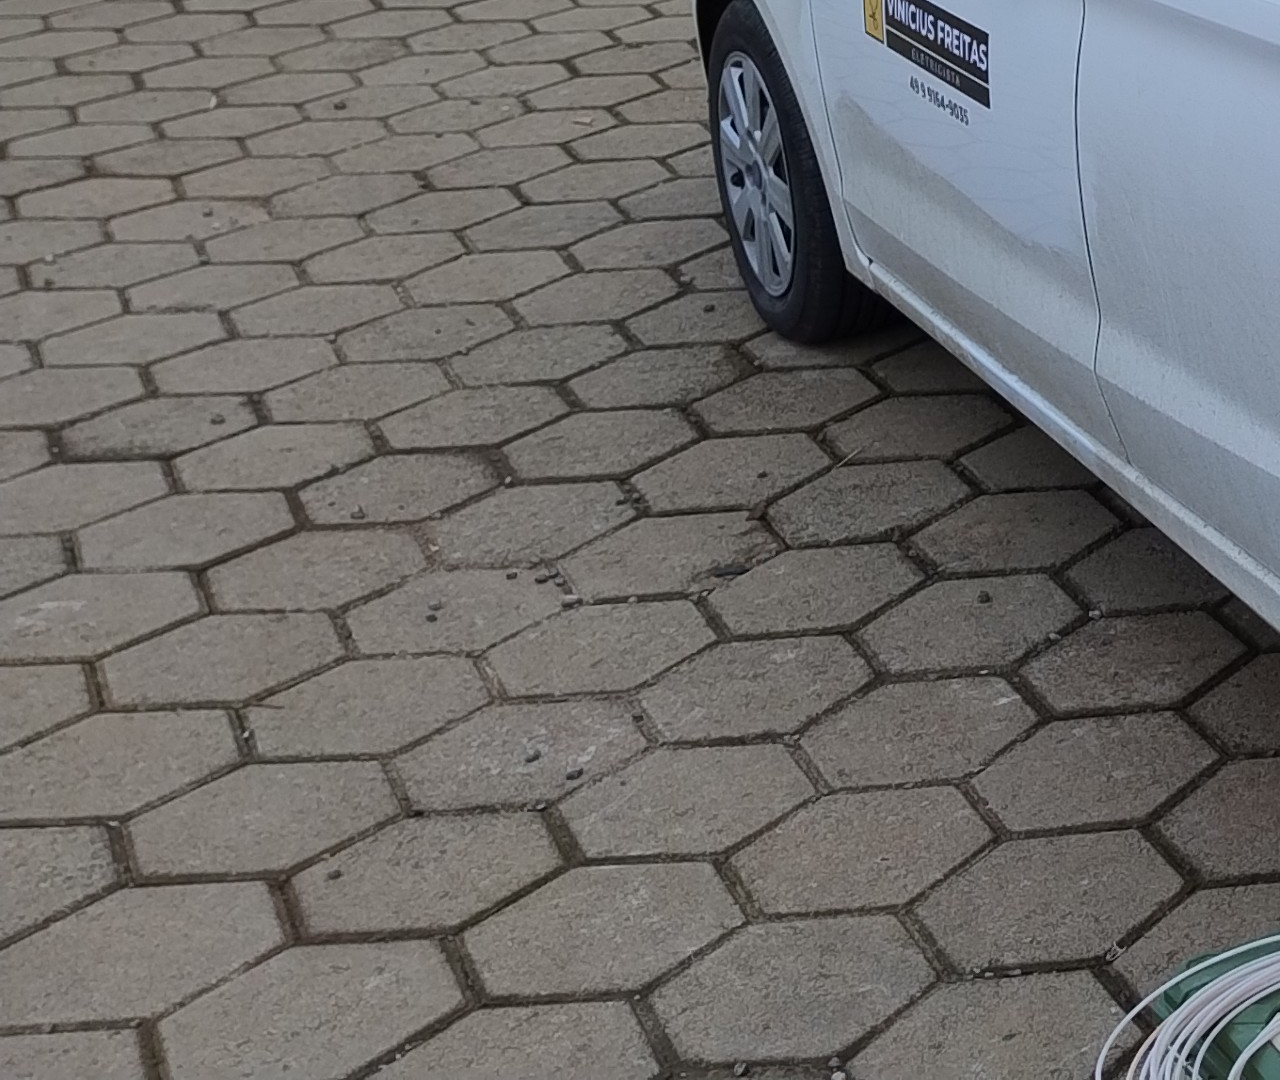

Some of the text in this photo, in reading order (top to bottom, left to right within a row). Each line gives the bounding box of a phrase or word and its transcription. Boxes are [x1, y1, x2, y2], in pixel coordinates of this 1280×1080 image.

[937, 20, 987, 71] FREITAS
[909, 75, 920, 95] 49
[920, 81, 926, 99] 9
[911, 47, 961, 88] ELETRICISTA
